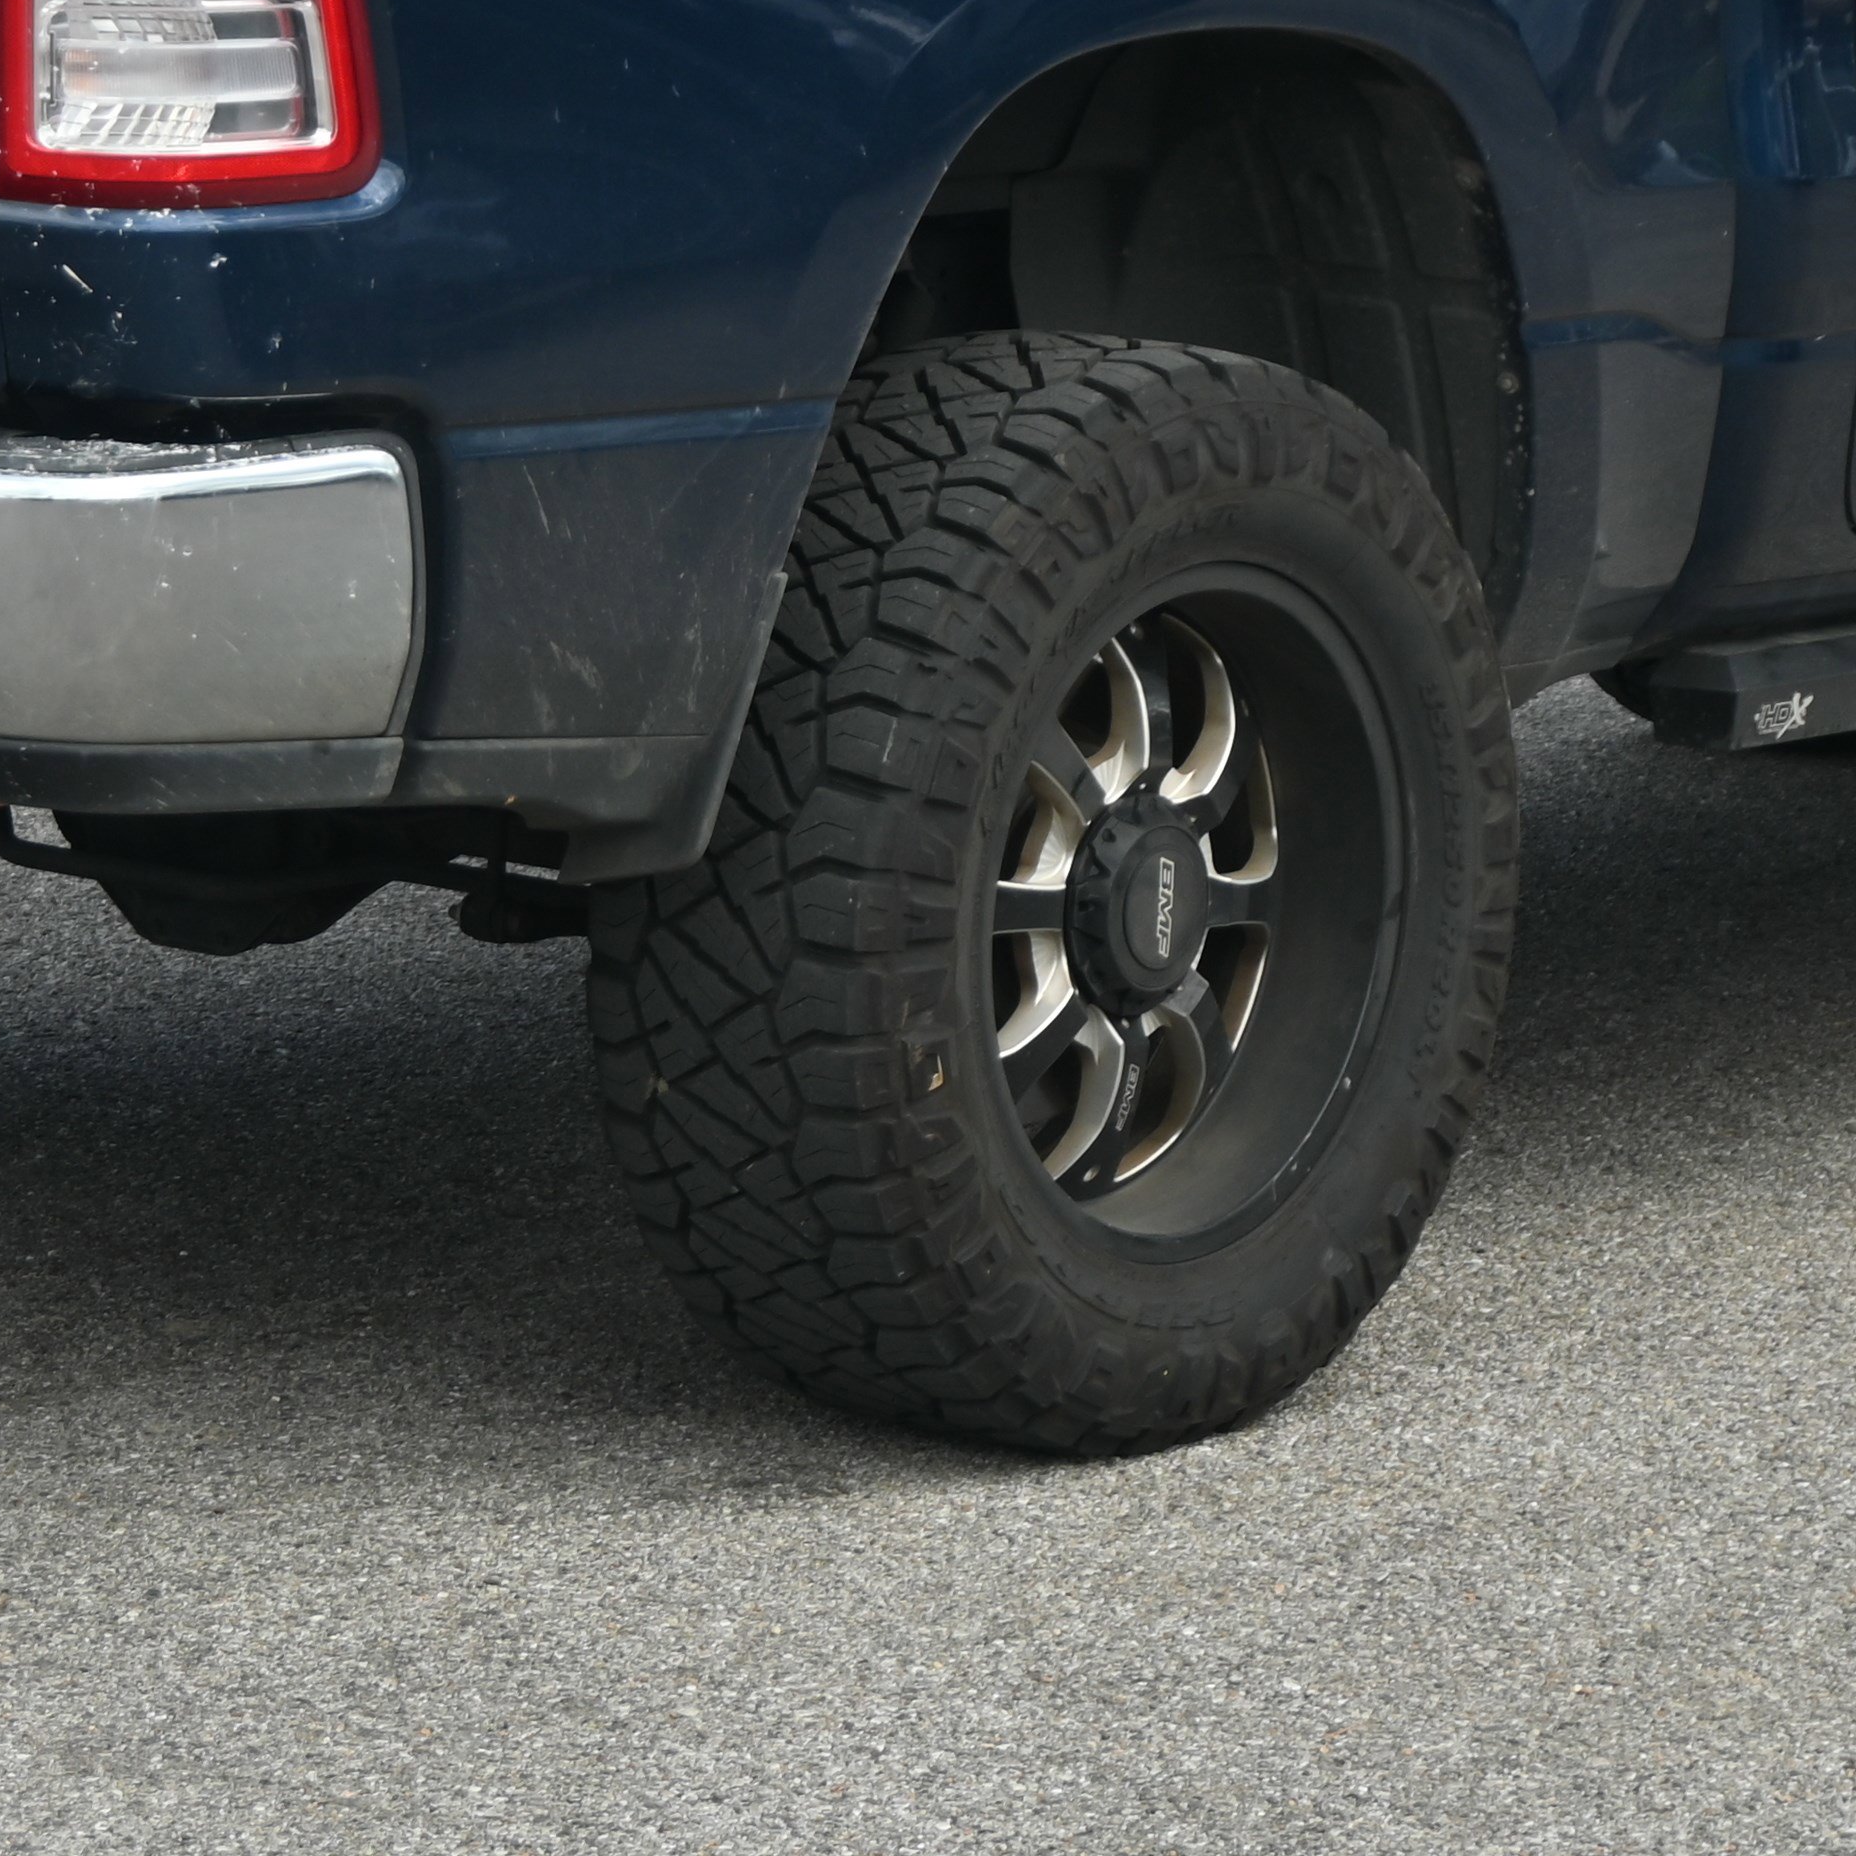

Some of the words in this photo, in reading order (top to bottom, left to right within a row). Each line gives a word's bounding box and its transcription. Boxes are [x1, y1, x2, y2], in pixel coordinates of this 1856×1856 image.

[1756, 691, 1815, 741] HDX
[1156, 855, 1175, 960] BMF
[1115, 1063, 1141, 1132] BMF
